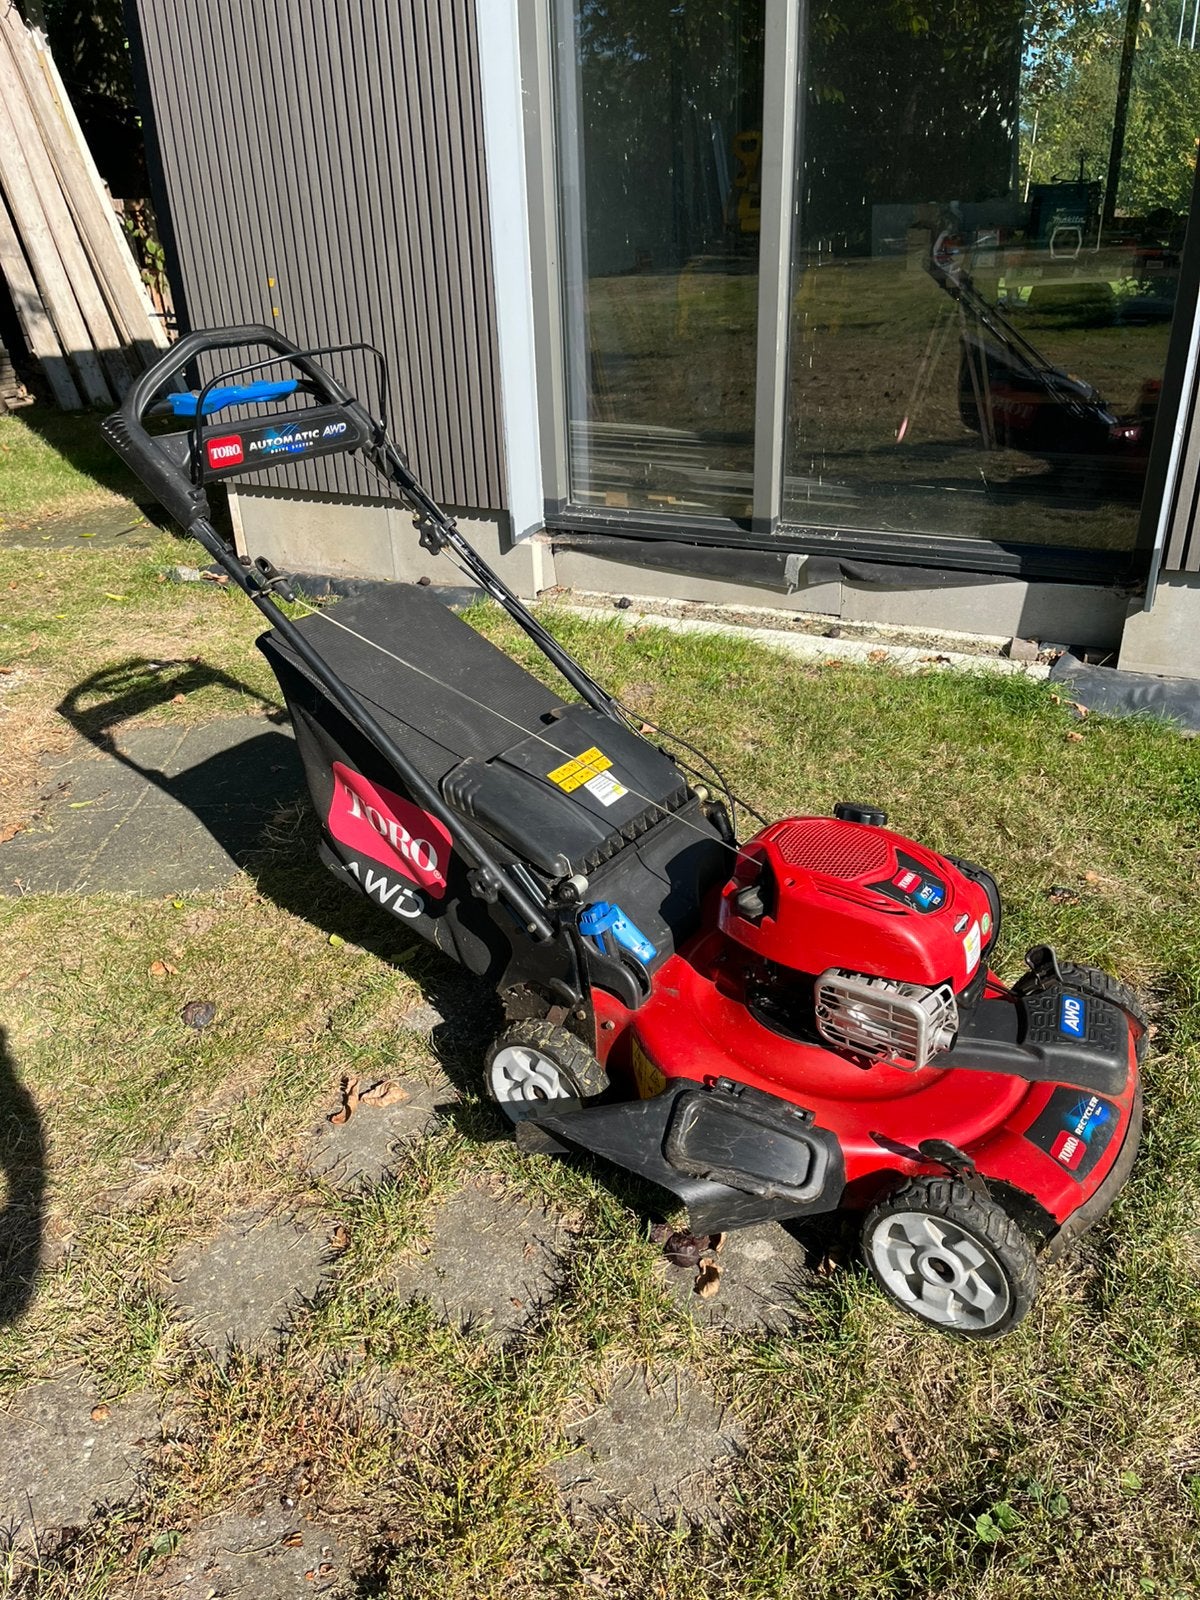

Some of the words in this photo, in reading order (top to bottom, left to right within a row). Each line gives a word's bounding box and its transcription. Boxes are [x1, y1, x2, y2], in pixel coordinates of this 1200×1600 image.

[249, 429, 320, 451] AUTOMATIC
[322, 422, 347, 437] AWD
[270, 446, 289, 454] DRIVE
[292, 441, 314, 451] SYSTEM
[210, 444, 241, 460] TORO
[344, 785, 438, 871] TORO
[342, 861, 425, 918] AWD
[898, 872, 916, 888] TORO
[920, 885, 933, 899] 675
[1064, 999, 1080, 1032] AWD
[1074, 1096, 1099, 1136] RECYCLER
[1058, 1136, 1080, 1163] TORO
